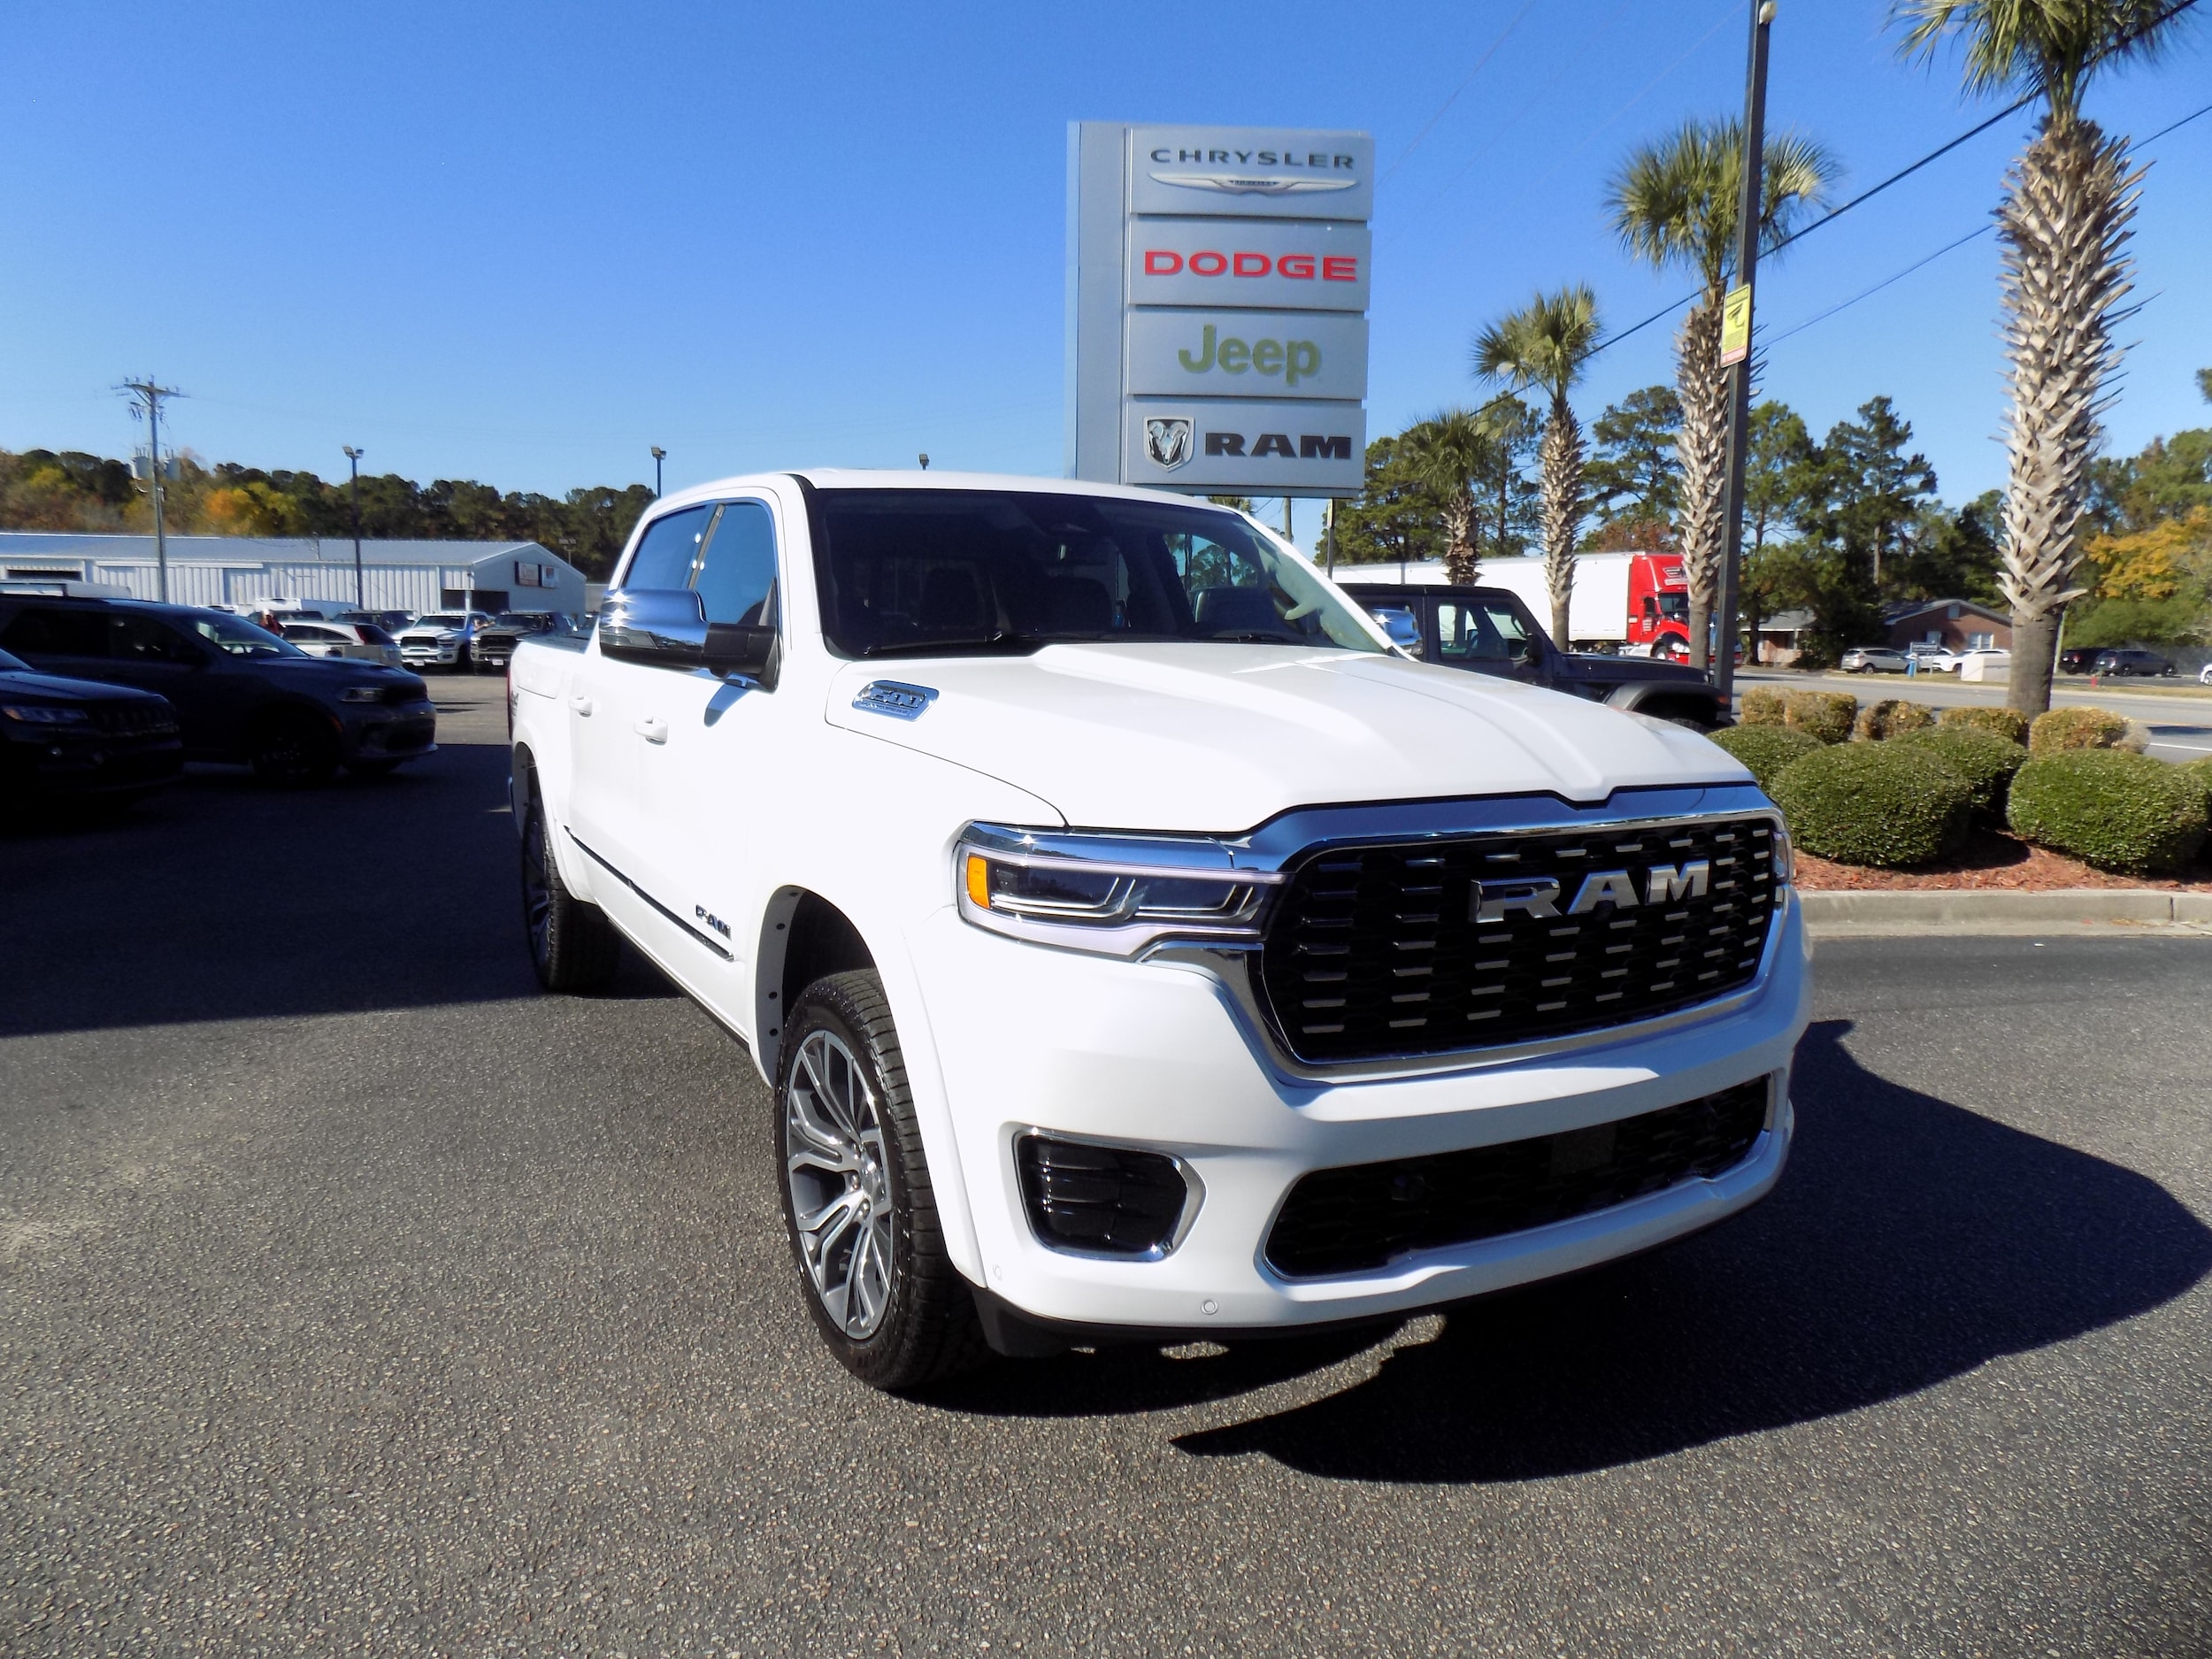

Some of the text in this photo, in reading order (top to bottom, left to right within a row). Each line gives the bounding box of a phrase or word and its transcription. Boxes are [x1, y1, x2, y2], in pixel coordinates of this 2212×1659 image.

[1150, 149, 1354, 169] CHRYSLER
[1144, 250, 1356, 282] DODGE
[1179, 325, 1321, 386] Jeep
[1205, 433, 1351, 459] RAM
[1469, 859, 1709, 924] RAM
[695, 904, 733, 941] RAM
